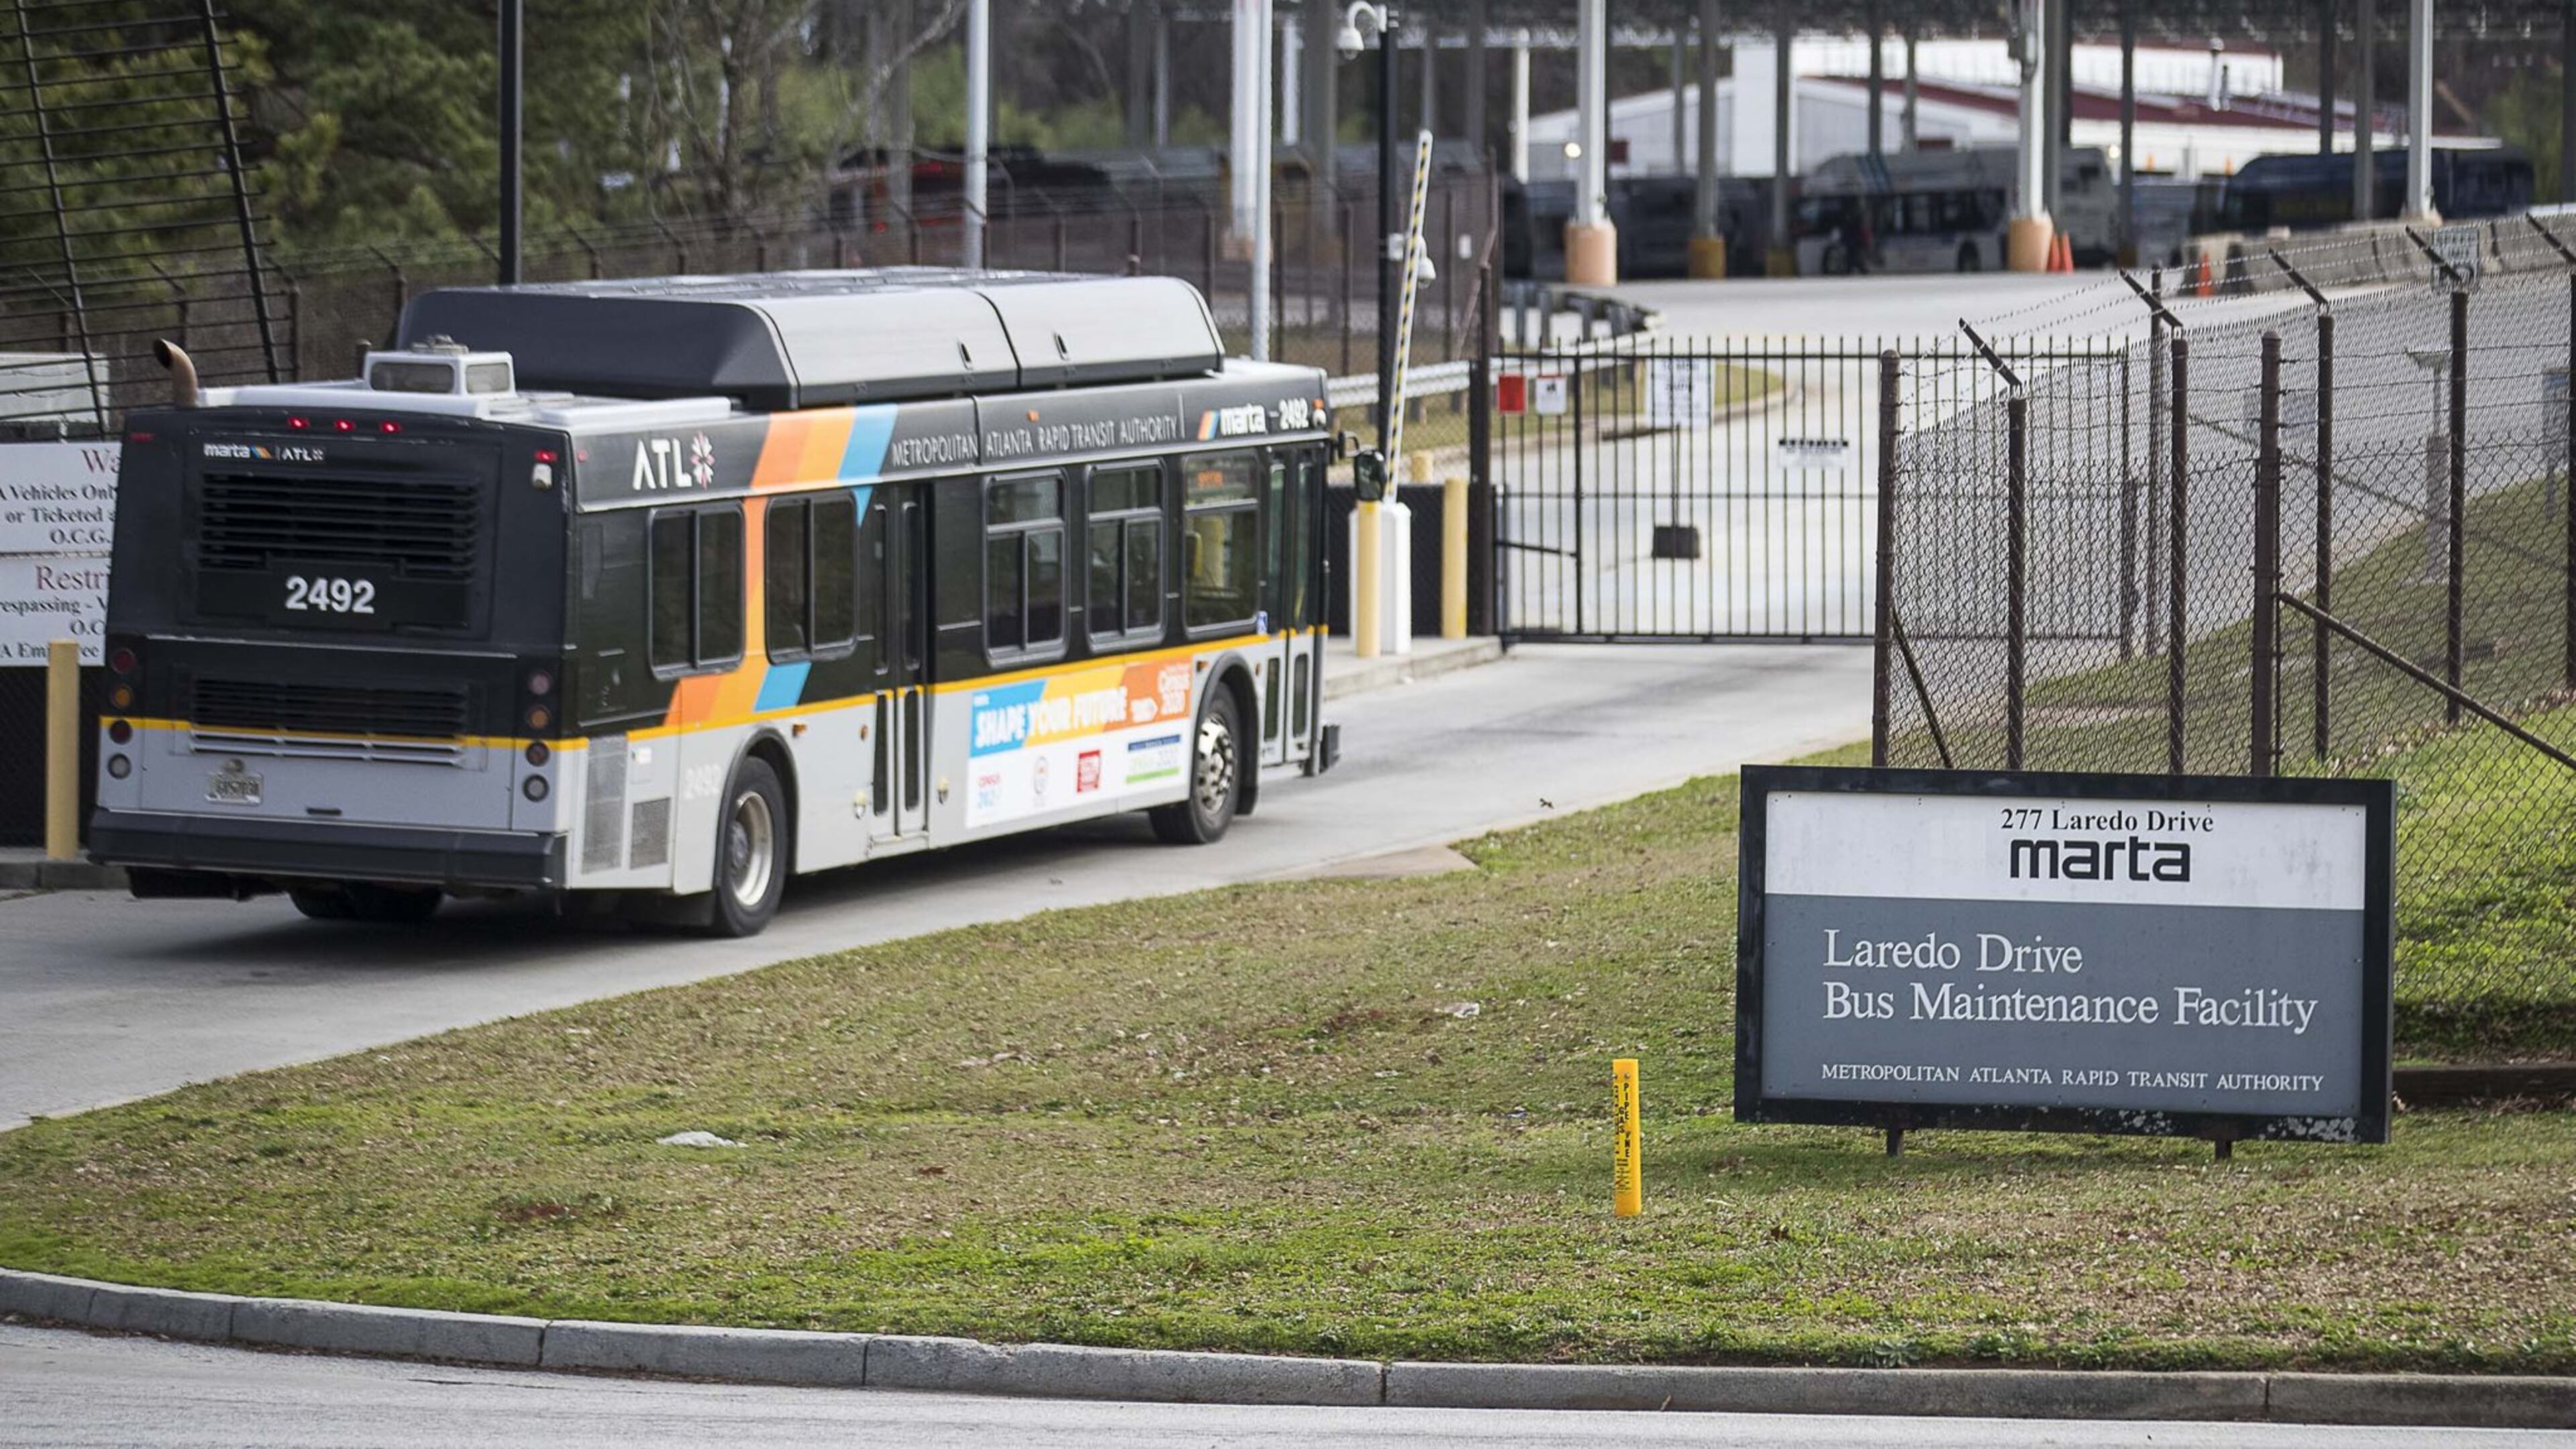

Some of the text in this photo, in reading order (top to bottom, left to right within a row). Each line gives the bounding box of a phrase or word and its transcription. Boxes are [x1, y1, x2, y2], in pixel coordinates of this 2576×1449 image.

[1220, 397, 1309, 436] marta 2492
[203, 443, 250, 459] marta
[892, 415, 1177, 467] METROPOLITAN ATLANTA RAPID TRANSIT AUTHORITY
[633, 437, 692, 491] ATL
[9, 484, 77, 500] Vehicles
[5, 511, 25, 524] or
[30, 506, 104, 523] Ticketed
[285, 575, 375, 614] 2492
[975, 704, 1026, 749] SHAPE
[1026, 697, 1072, 737] YOUR
[1073, 686, 1128, 730] FUTURE
[2001, 809, 2214, 832] 277 Laredo Drive
[2010, 836, 2191, 882] marta
[1823, 929, 2083, 974] Laredo Drive
[1823, 981, 2319, 1035] Bus Maintenance Facility
[1821, 1064, 2324, 1091] METROPOLITAN ATLANTA RAPID TRANSIT AUTHORITY
